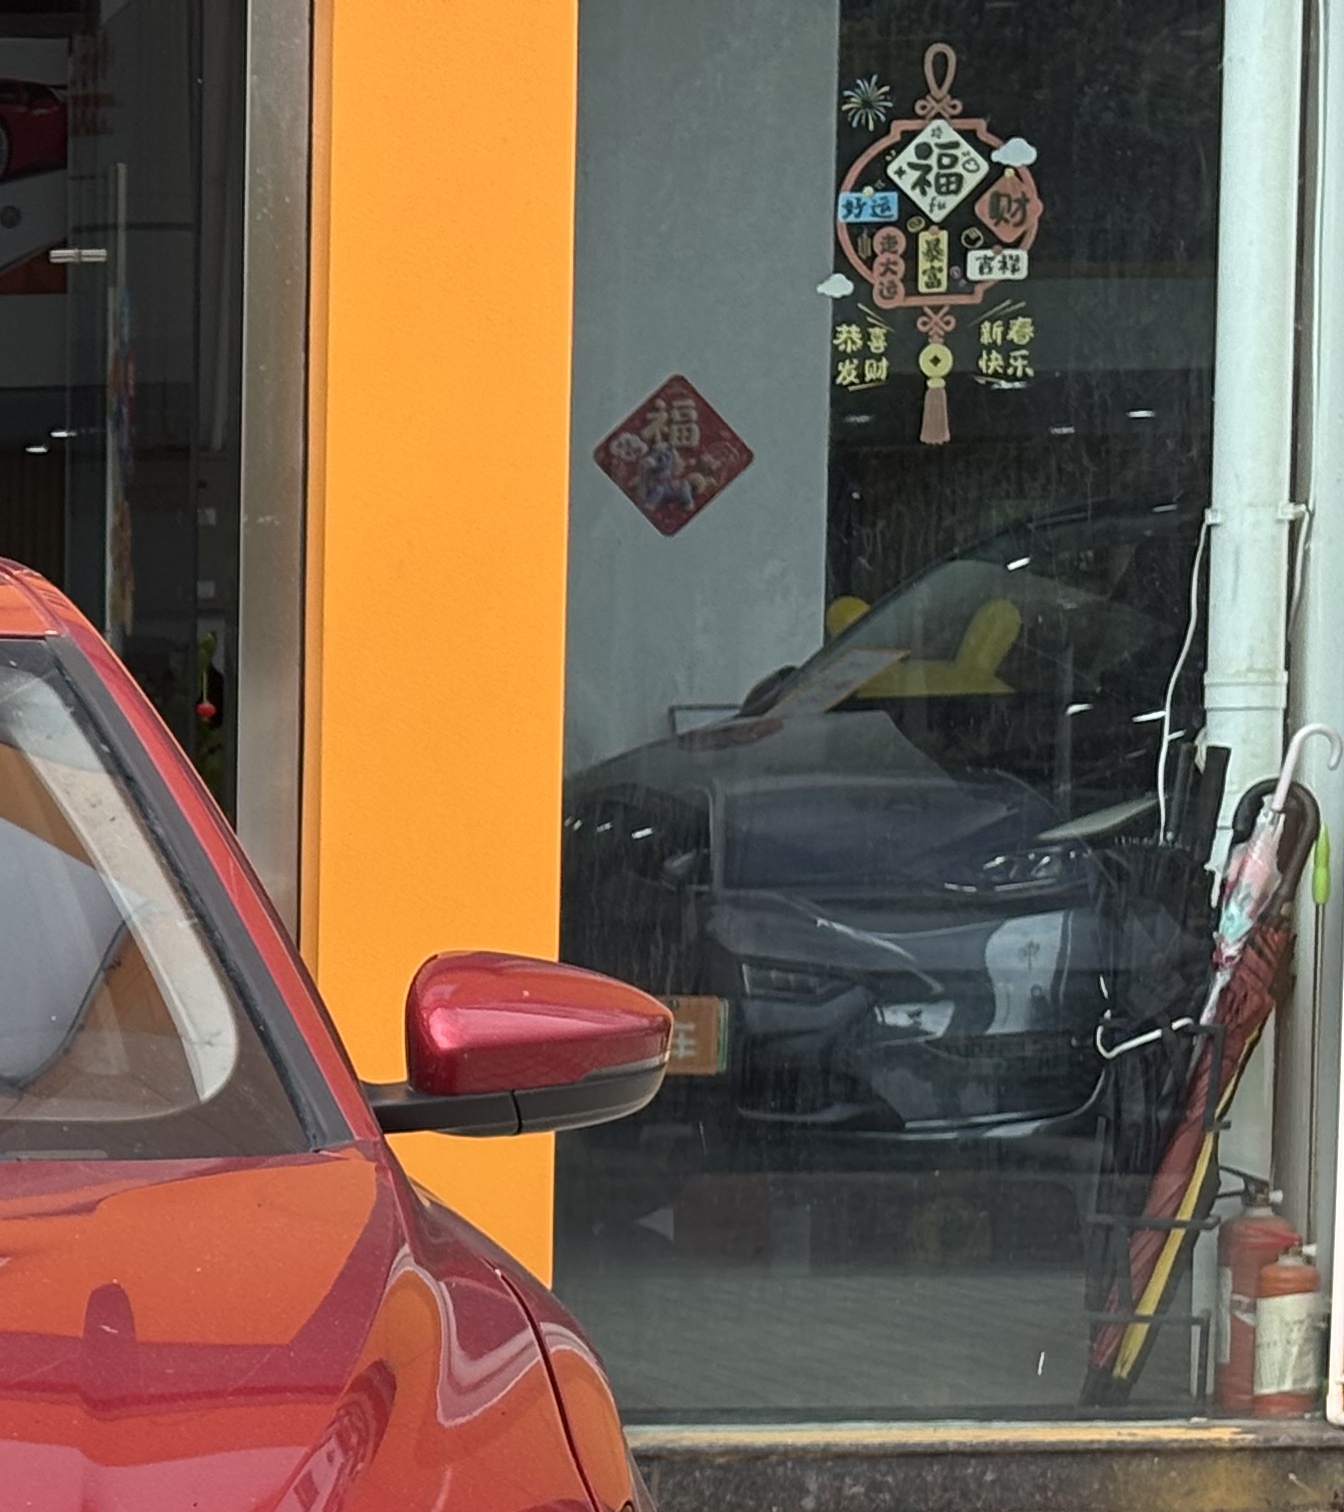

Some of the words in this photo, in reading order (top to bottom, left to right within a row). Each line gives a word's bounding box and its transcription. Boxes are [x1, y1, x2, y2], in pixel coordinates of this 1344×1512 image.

[907, 140, 963, 197] 福
[841, 197, 895, 219] 好运
[988, 190, 1030, 227] 财
[878, 232, 900, 300] 走大运
[833, 323, 889, 354] 恭喜
[979, 315, 1035, 346] 新春
[835, 356, 889, 385] 发财
[977, 349, 1034, 379] 快乐
[640, 398, 701, 448] 福
